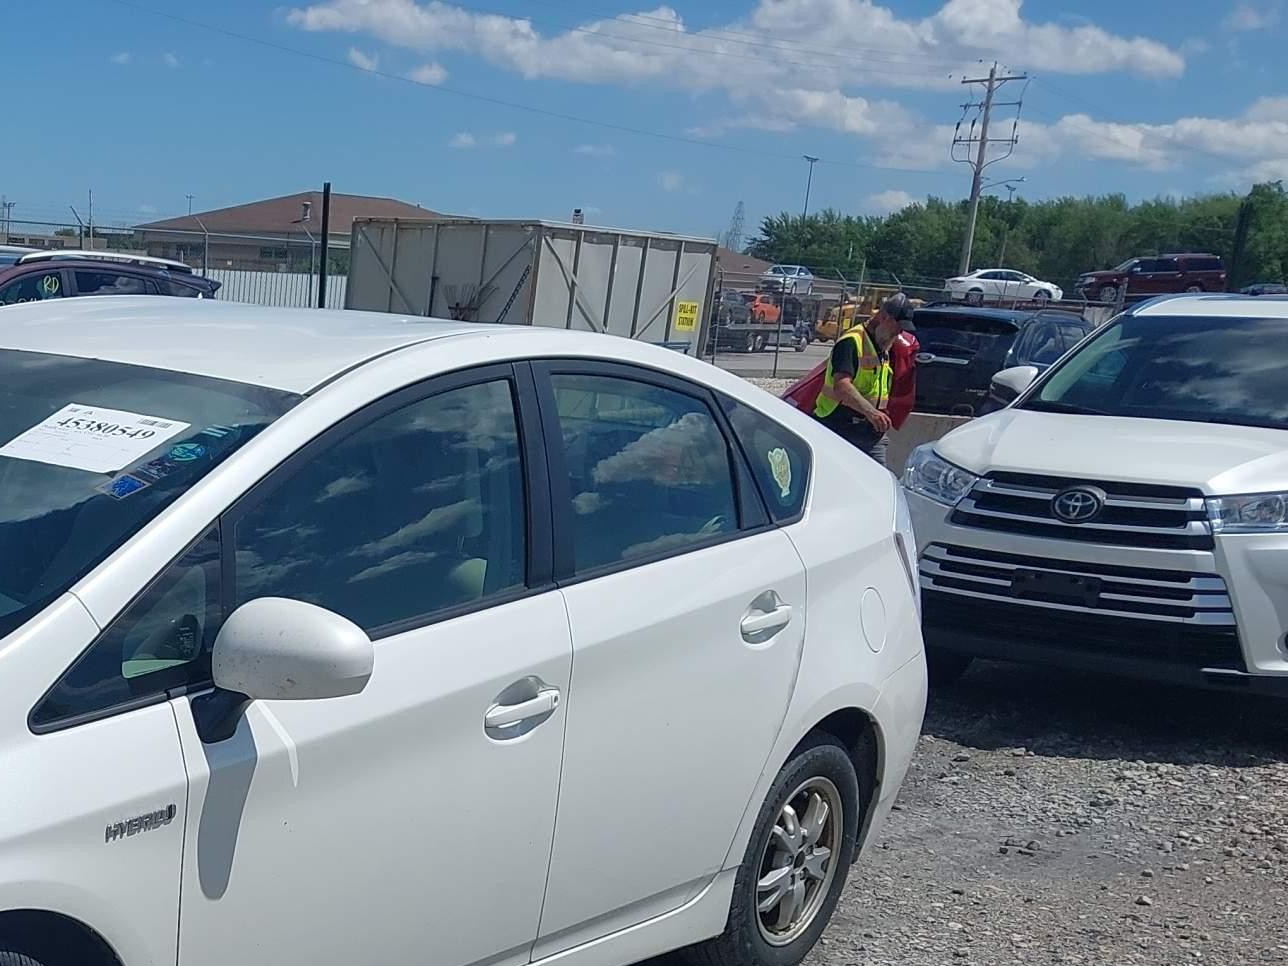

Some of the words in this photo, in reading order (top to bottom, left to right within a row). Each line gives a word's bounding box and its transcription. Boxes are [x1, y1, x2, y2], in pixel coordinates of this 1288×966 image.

[678, 316, 694, 326] STATION
[57, 418, 155, 440] 45380549
[105, 804, 176, 843] HYBRID
